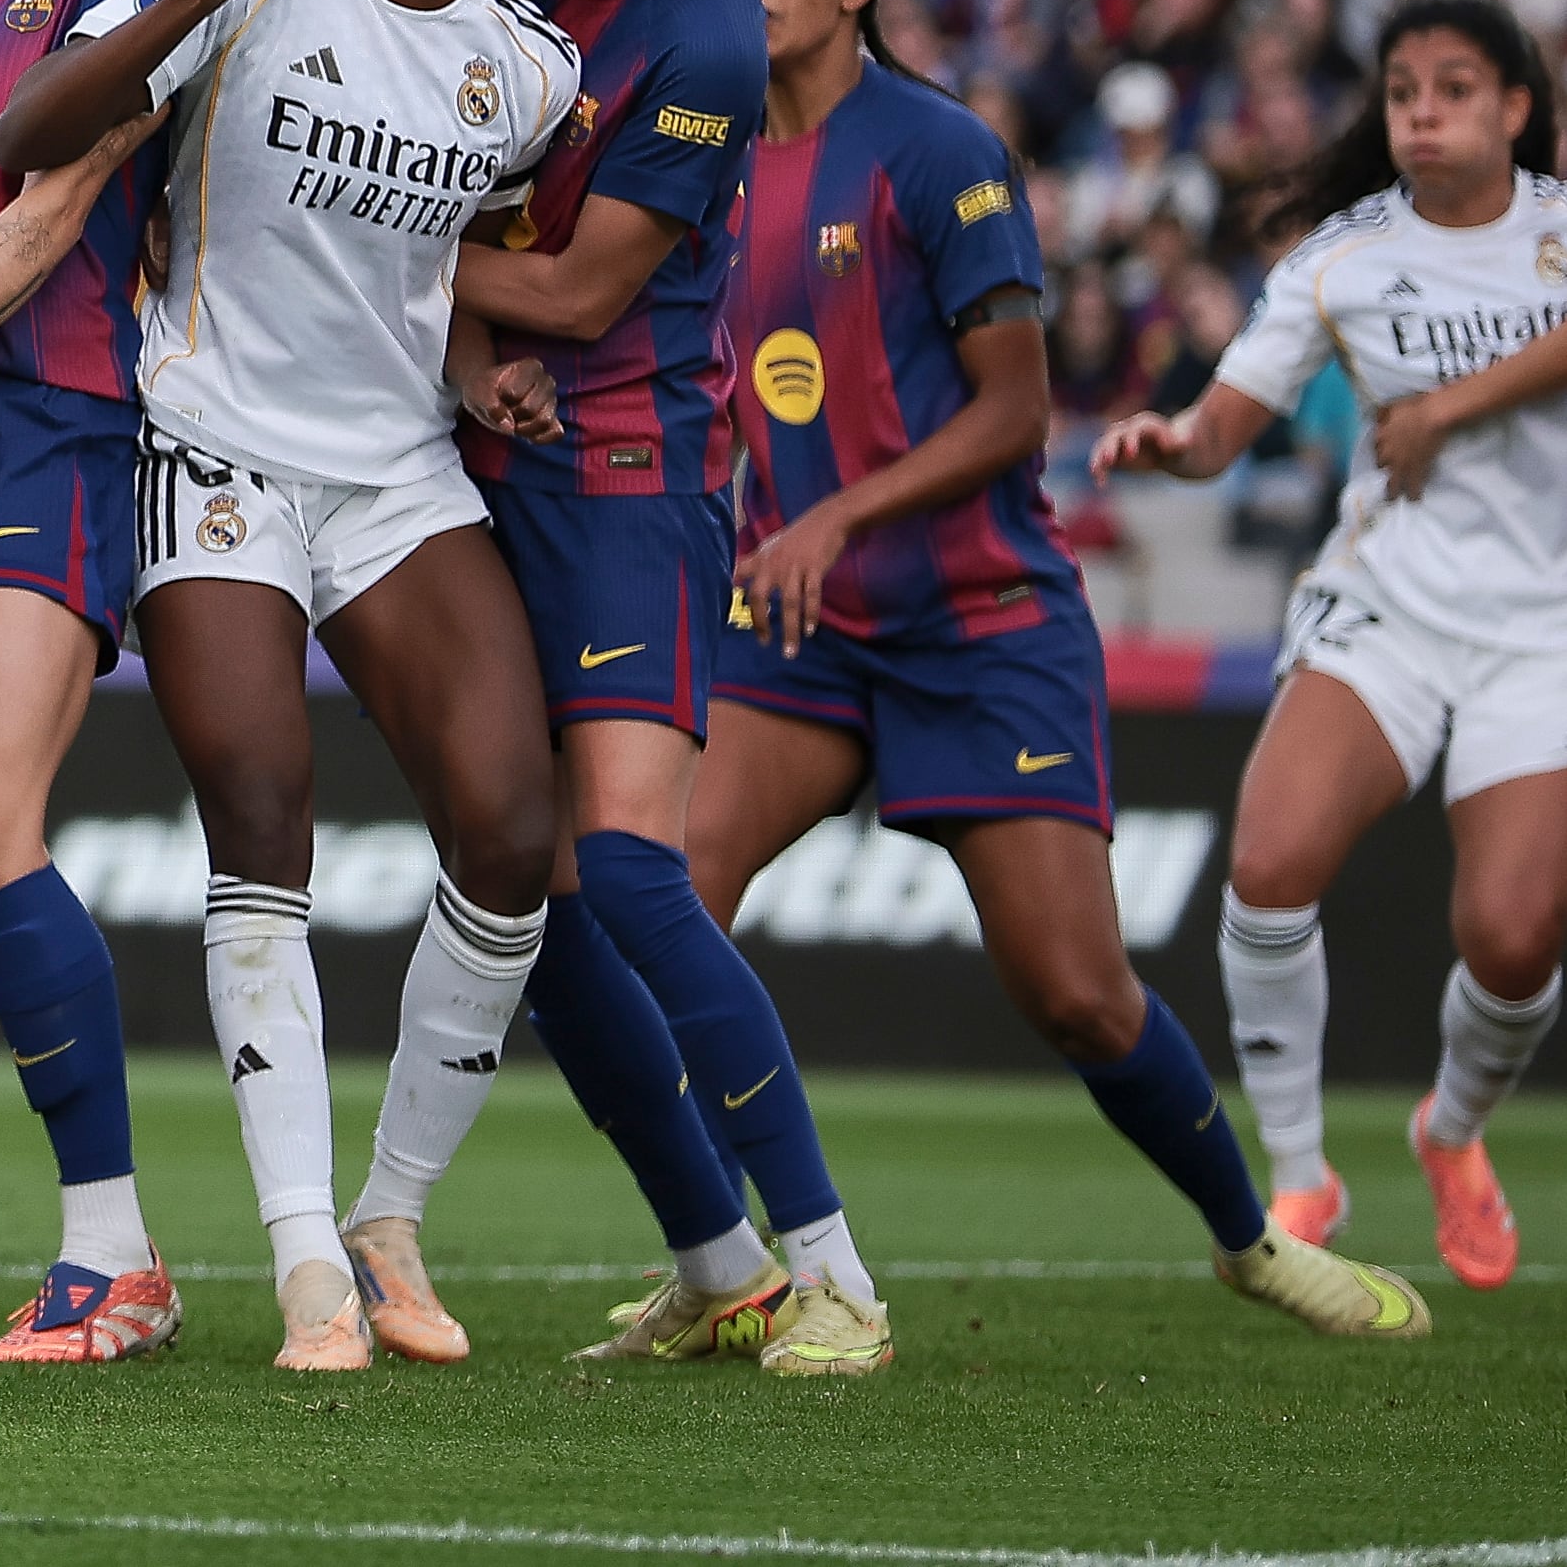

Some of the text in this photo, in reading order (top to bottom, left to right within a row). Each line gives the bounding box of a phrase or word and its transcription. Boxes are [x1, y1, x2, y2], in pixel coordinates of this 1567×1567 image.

[266, 93, 500, 193] Emirates
[288, 166, 464, 238] FLY BETTER
[1391, 300, 1567, 356] Emirat
